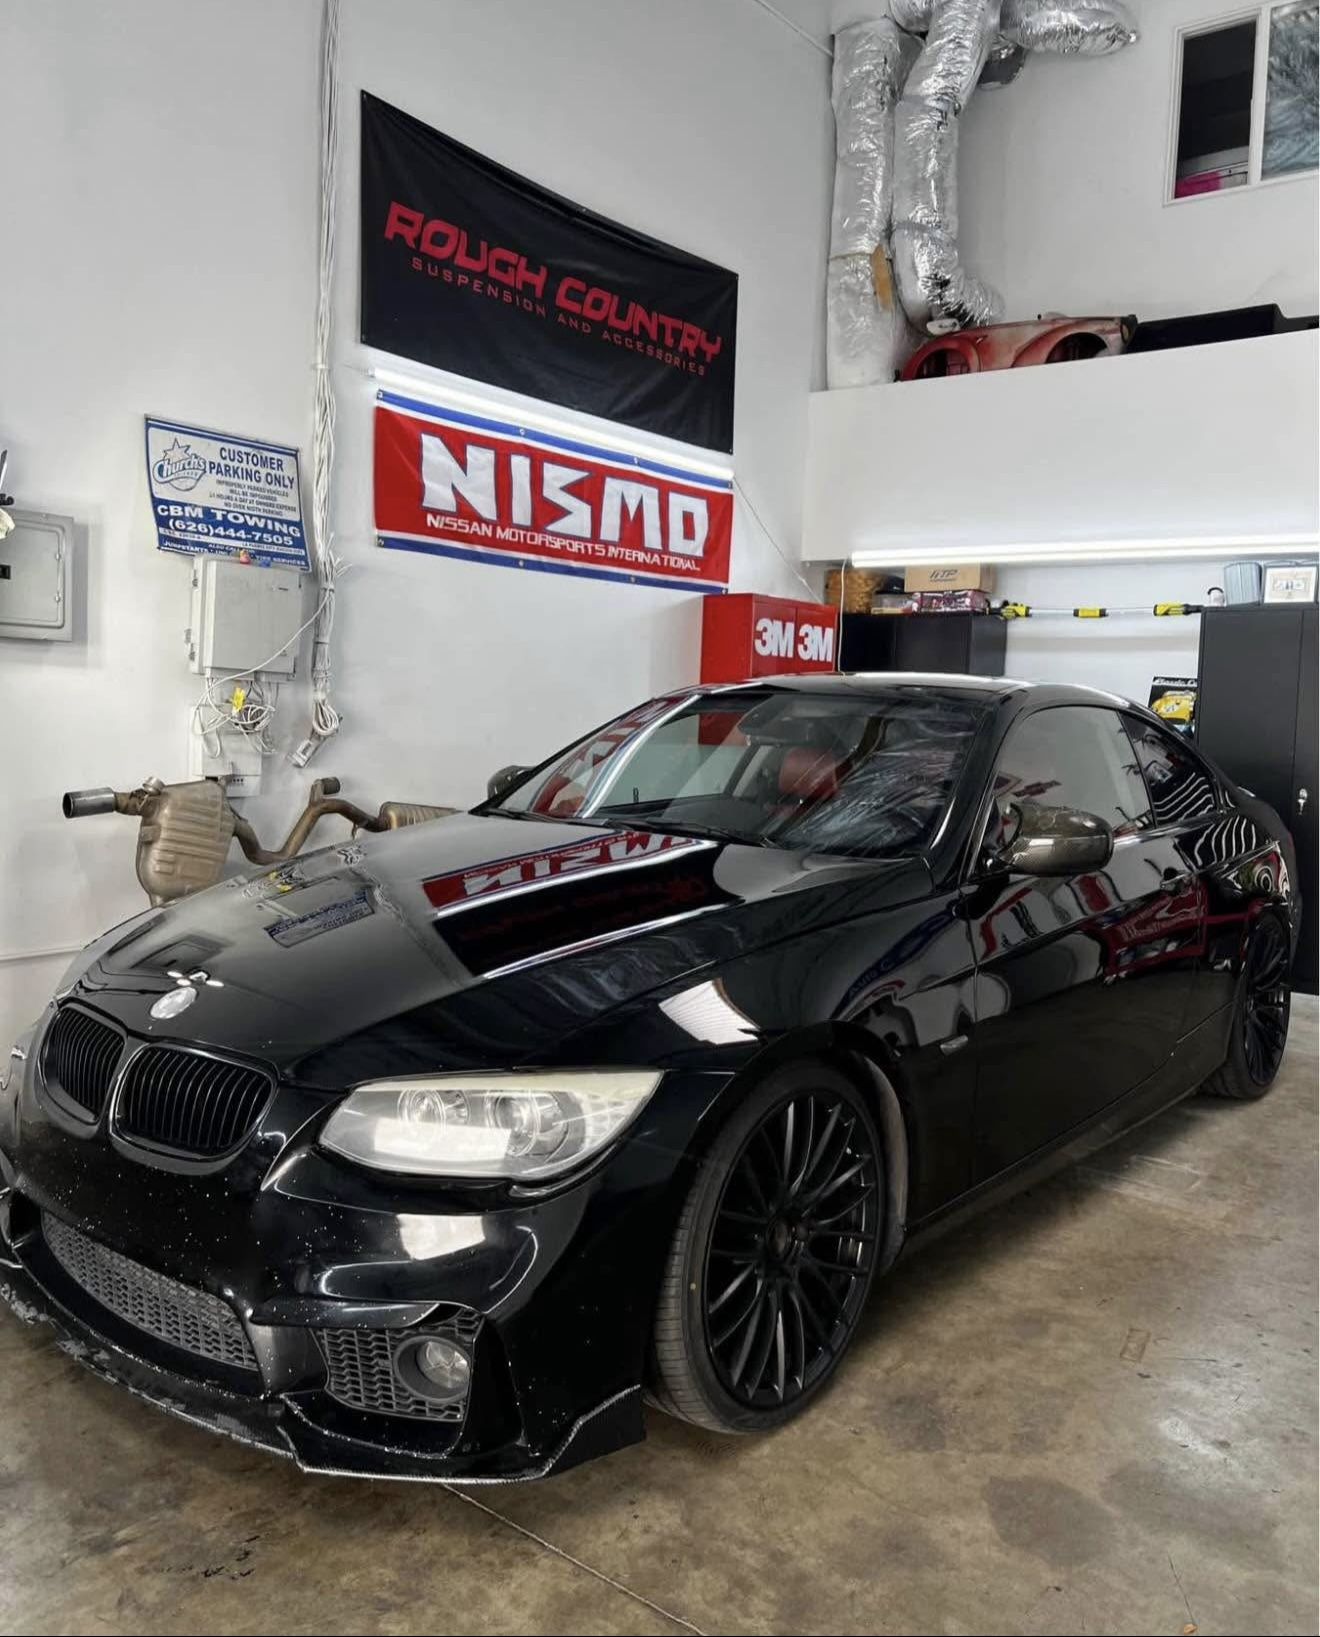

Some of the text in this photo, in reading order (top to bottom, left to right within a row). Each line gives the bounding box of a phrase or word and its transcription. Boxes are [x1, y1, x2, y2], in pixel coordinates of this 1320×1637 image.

[384, 201, 722, 363] ROUGH COUNTRY
[411, 257, 705, 376] SUSPENSION AND ACCESSORIES
[209, 461, 294, 489] PARKING ONLY
[219, 447, 283, 472] CUSTOMER
[420, 432, 708, 557] NISMO
[157, 504, 203, 518] CBM
[211, 508, 300, 537] TOWING
[169, 518, 294, 546] (626)444-7505
[426, 513, 700, 572] NISSAN MOTORSPORTS INTERNATIONAL
[754, 618, 832, 662] 3M 3M
